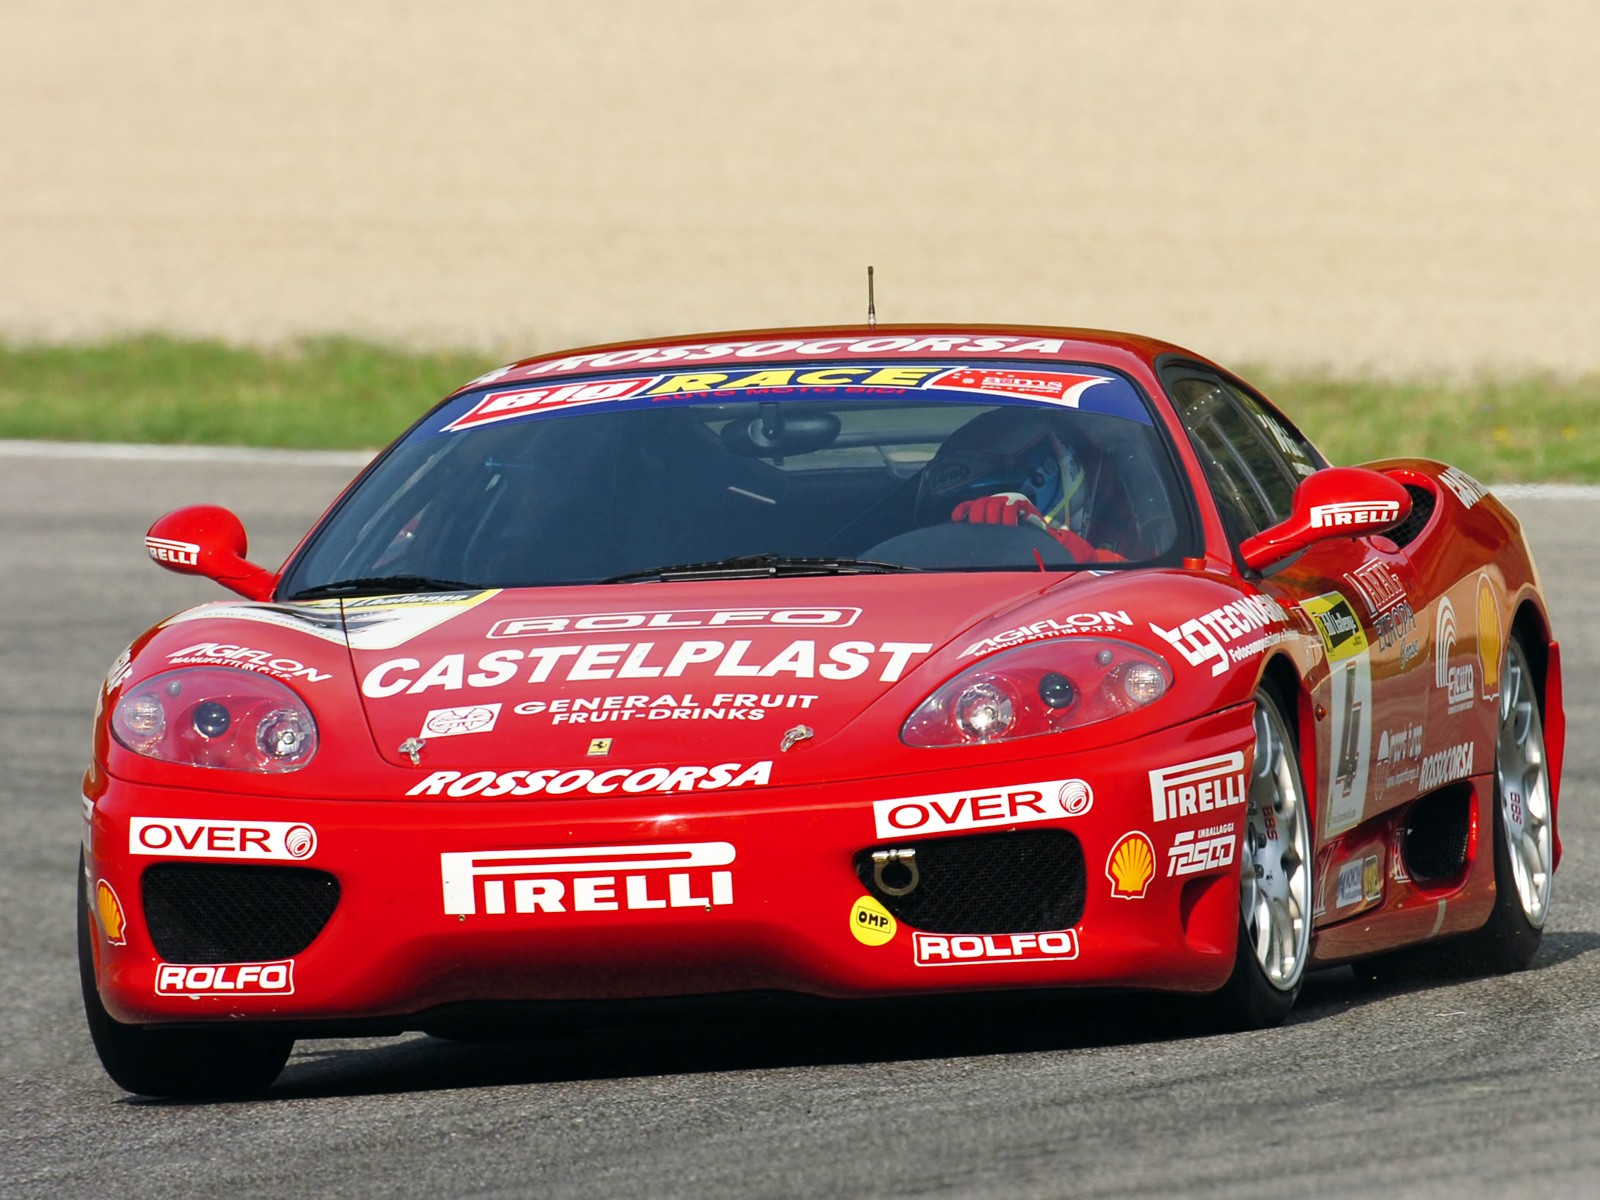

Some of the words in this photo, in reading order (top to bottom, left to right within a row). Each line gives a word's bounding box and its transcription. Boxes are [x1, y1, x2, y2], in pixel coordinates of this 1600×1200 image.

[526, 338, 1064, 375] ROSSOCORSA
[646, 367, 942, 395] RACE
[652, 390, 736, 402] AUTO
[746, 387, 836, 395] MOTO
[1310, 501, 1400, 528] PIRELLI
[504, 608, 846, 635] ROLFO
[956, 610, 1134, 660] AGIFLON
[974, 629, 1060, 657] MANUFATTI
[165, 642, 333, 683] AGIFLON
[169, 657, 242, 668] MANUFATTI
[361, 639, 934, 699] CASTELPLAST
[514, 694, 706, 716] GENERAL
[712, 694, 818, 708] FRUIT
[552, 706, 766, 726] FRUIT-DRINKS
[405, 760, 773, 797] ROSSOCORSA
[1418, 741, 1475, 792] ROSSOCORSA
[1148, 750, 1246, 822] PIRELLI
[888, 790, 1047, 829] OVER
[139, 824, 272, 853] OVER
[440, 841, 737, 915] PIRELLI
[859, 910, 890, 929] OMP
[919, 932, 1072, 960] ROLFO
[160, 965, 288, 990] ROLFO
